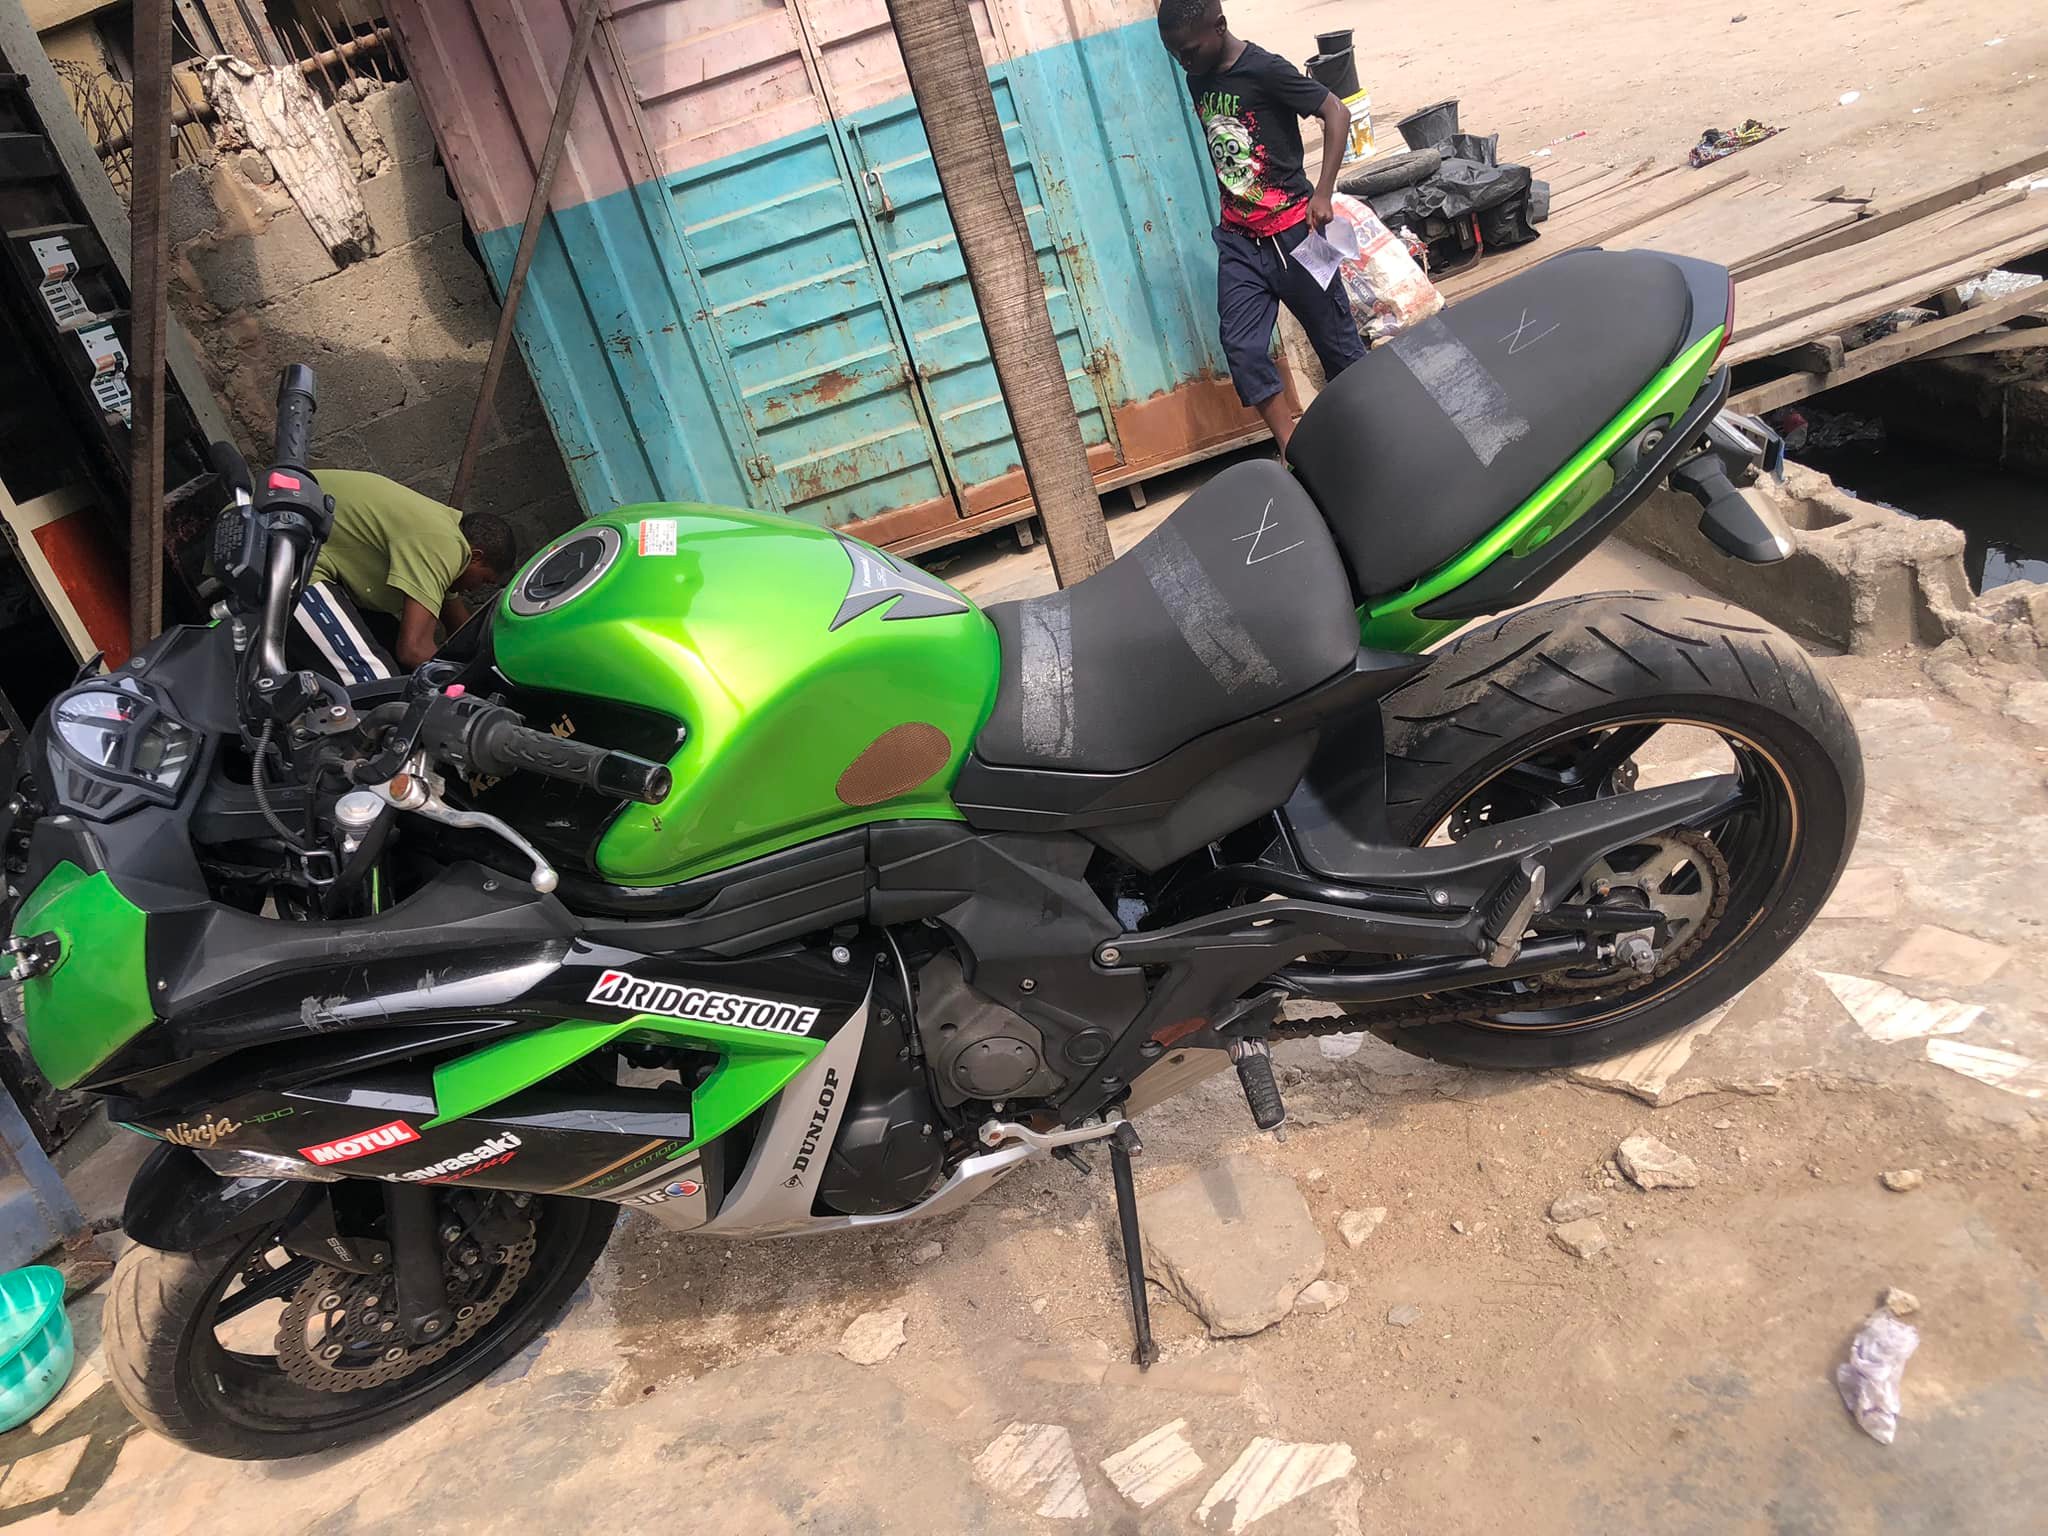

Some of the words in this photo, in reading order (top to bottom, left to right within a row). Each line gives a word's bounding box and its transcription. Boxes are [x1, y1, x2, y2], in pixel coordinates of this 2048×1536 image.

[1203, 91, 1240, 117] SCARE
[591, 973, 815, 1034] BRIDGESTONE
[165, 1113, 242, 1148] Ninja
[792, 1067, 839, 1173] DUNLOP
[310, 1125, 402, 1163] MOTUL
[376, 1131, 523, 1183] Kawasaki
